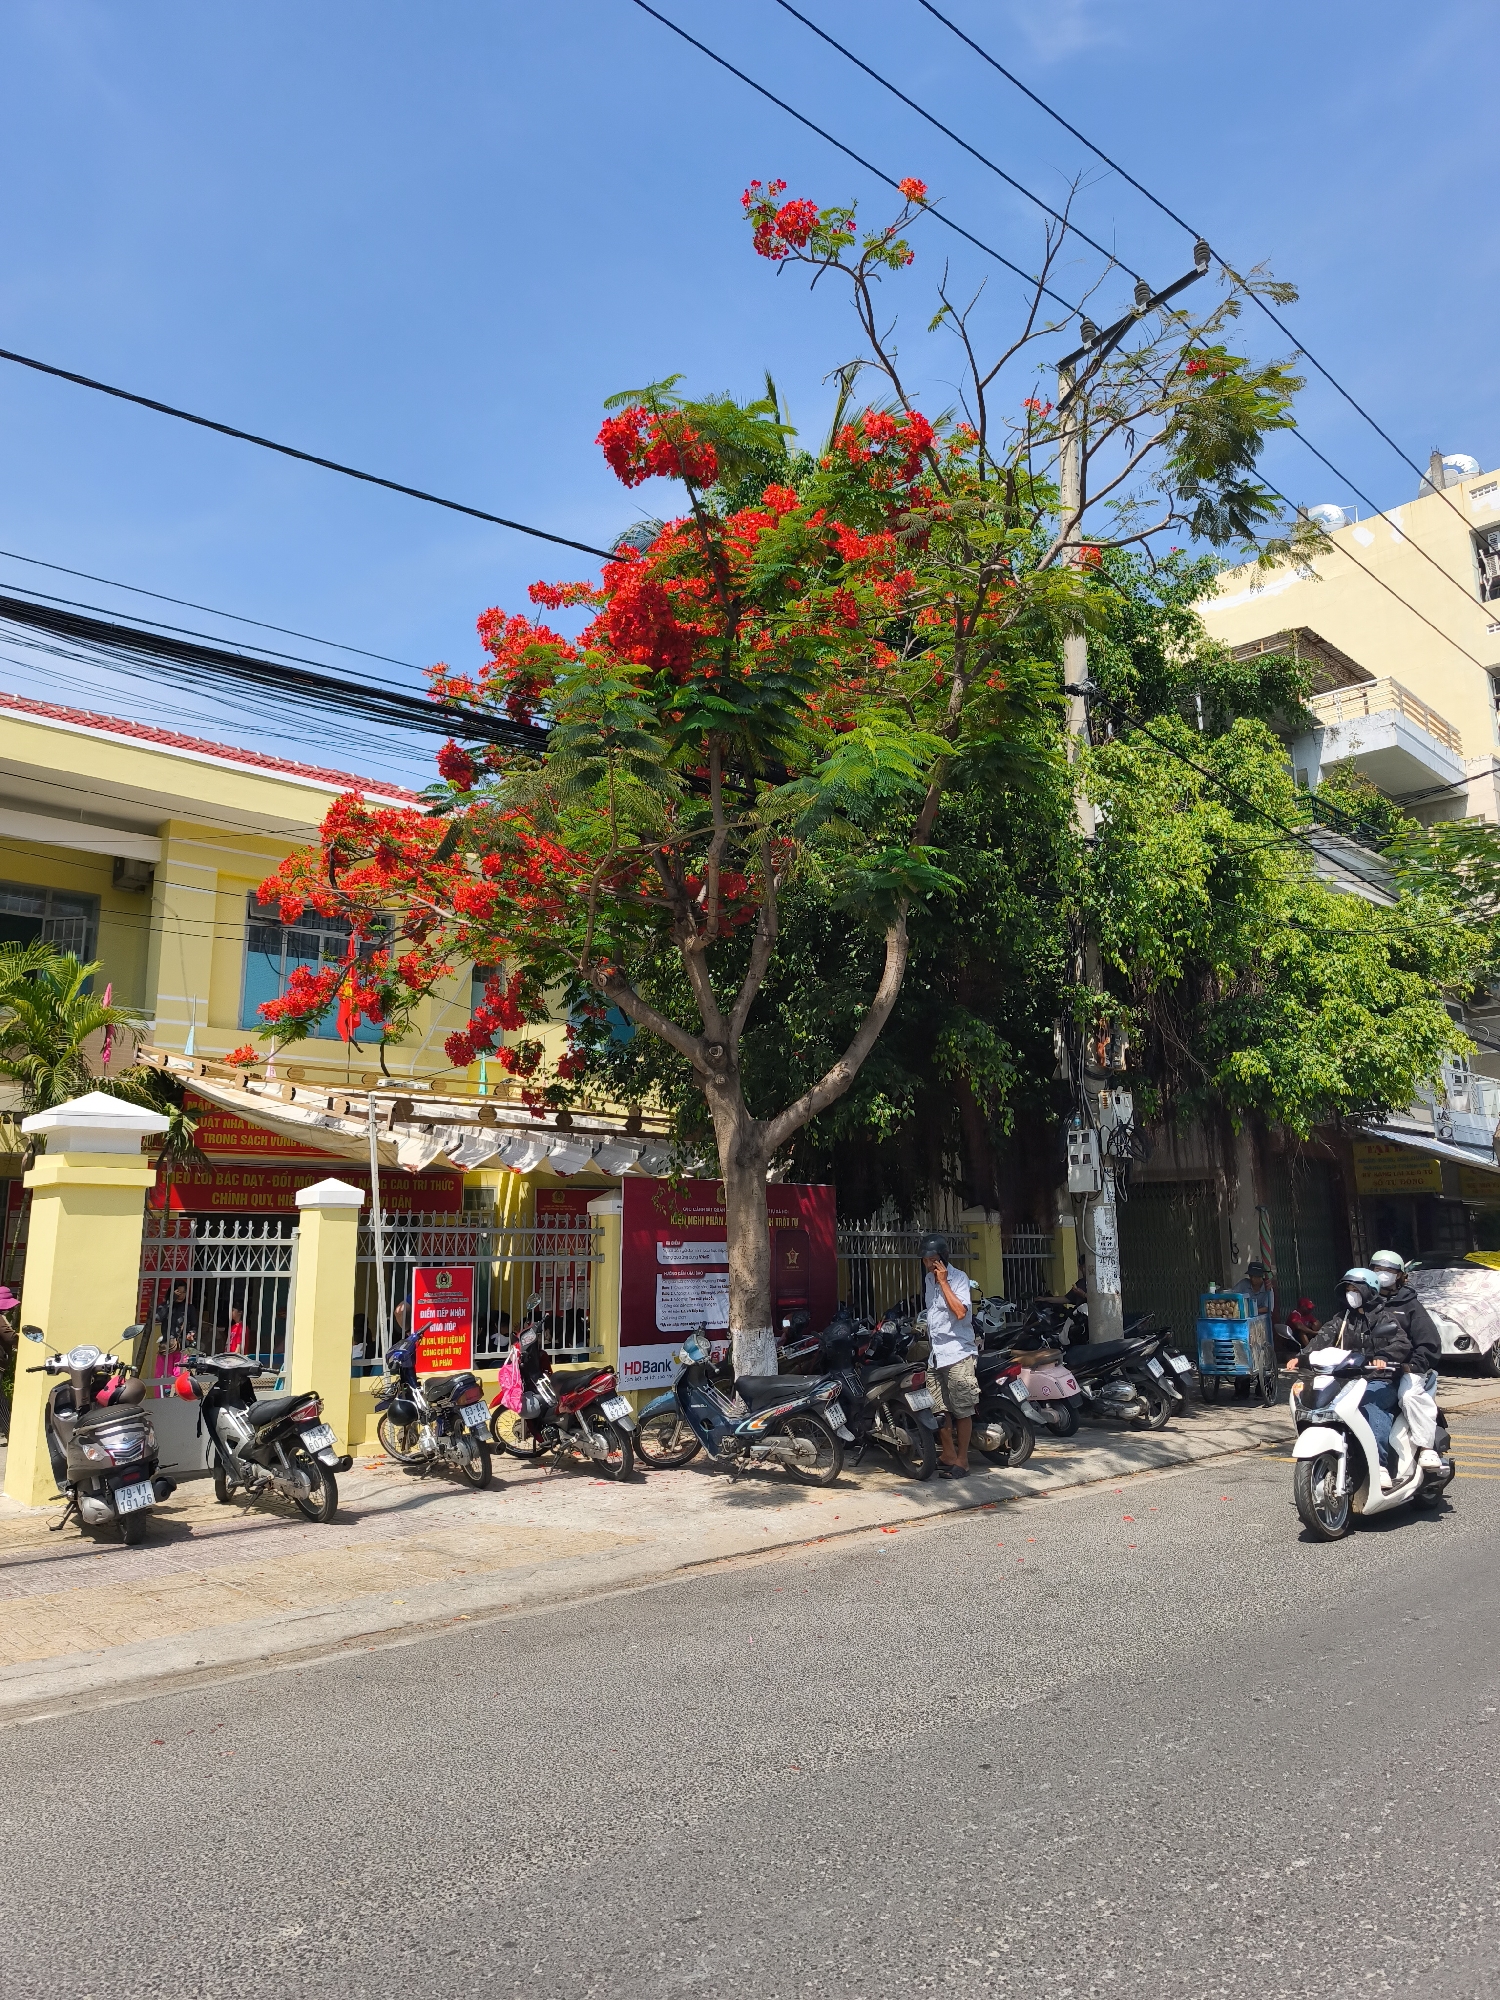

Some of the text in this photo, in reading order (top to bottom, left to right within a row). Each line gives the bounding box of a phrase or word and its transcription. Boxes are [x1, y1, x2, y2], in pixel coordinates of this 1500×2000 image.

[203, 1133, 237, 1145] TRONG
[240, 1135, 267, 1147] SẠCH
[216, 1171, 239, 1185] BÁC
[243, 1174, 264, 1188] DẠY
[390, 1179, 410, 1191] CAO
[431, 1176, 455, 1191] THỨC
[212, 1190, 248, 1206] CHÍNH
[251, 1193, 274, 1207] QUY,
[391, 1195, 412, 1208] DÂN
[420, 1306, 436, 1319] ĐIỂM
[624, 1358, 672, 1376] HDBank
[468, 1411, 487, 1425] 0452
[120, 1493, 153, 1512] 191.26
